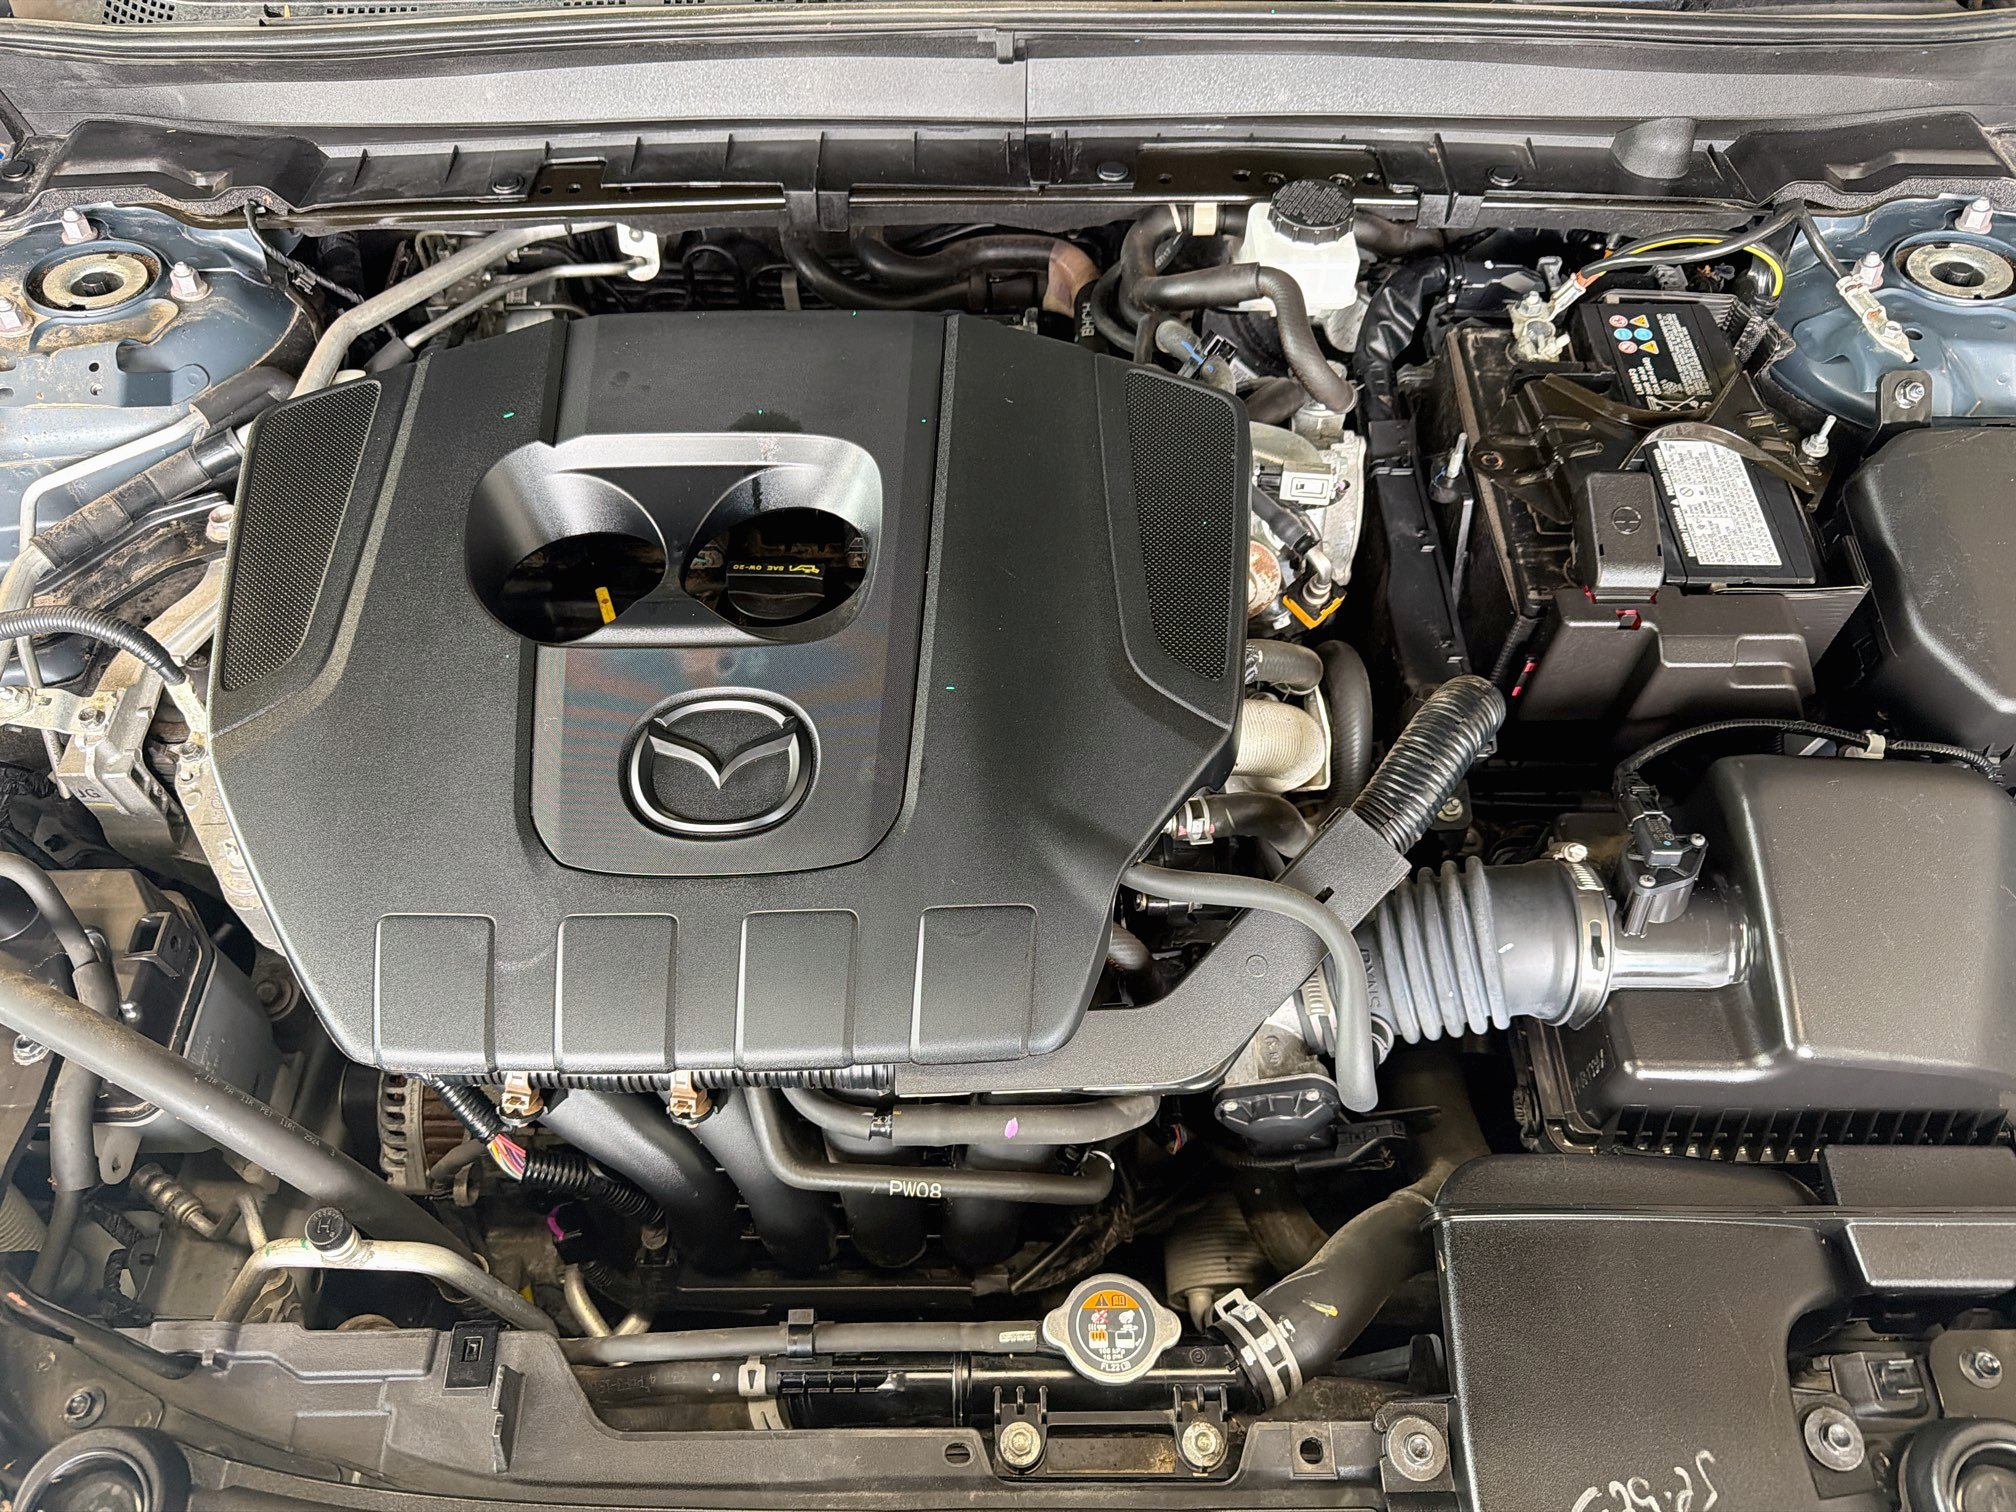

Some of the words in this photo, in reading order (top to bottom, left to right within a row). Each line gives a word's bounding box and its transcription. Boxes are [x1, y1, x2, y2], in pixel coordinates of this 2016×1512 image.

[889, 1179, 942, 1199] PW08
[316, 1218, 332, 1234] H
[1100, 1361, 1121, 1371] FL22
